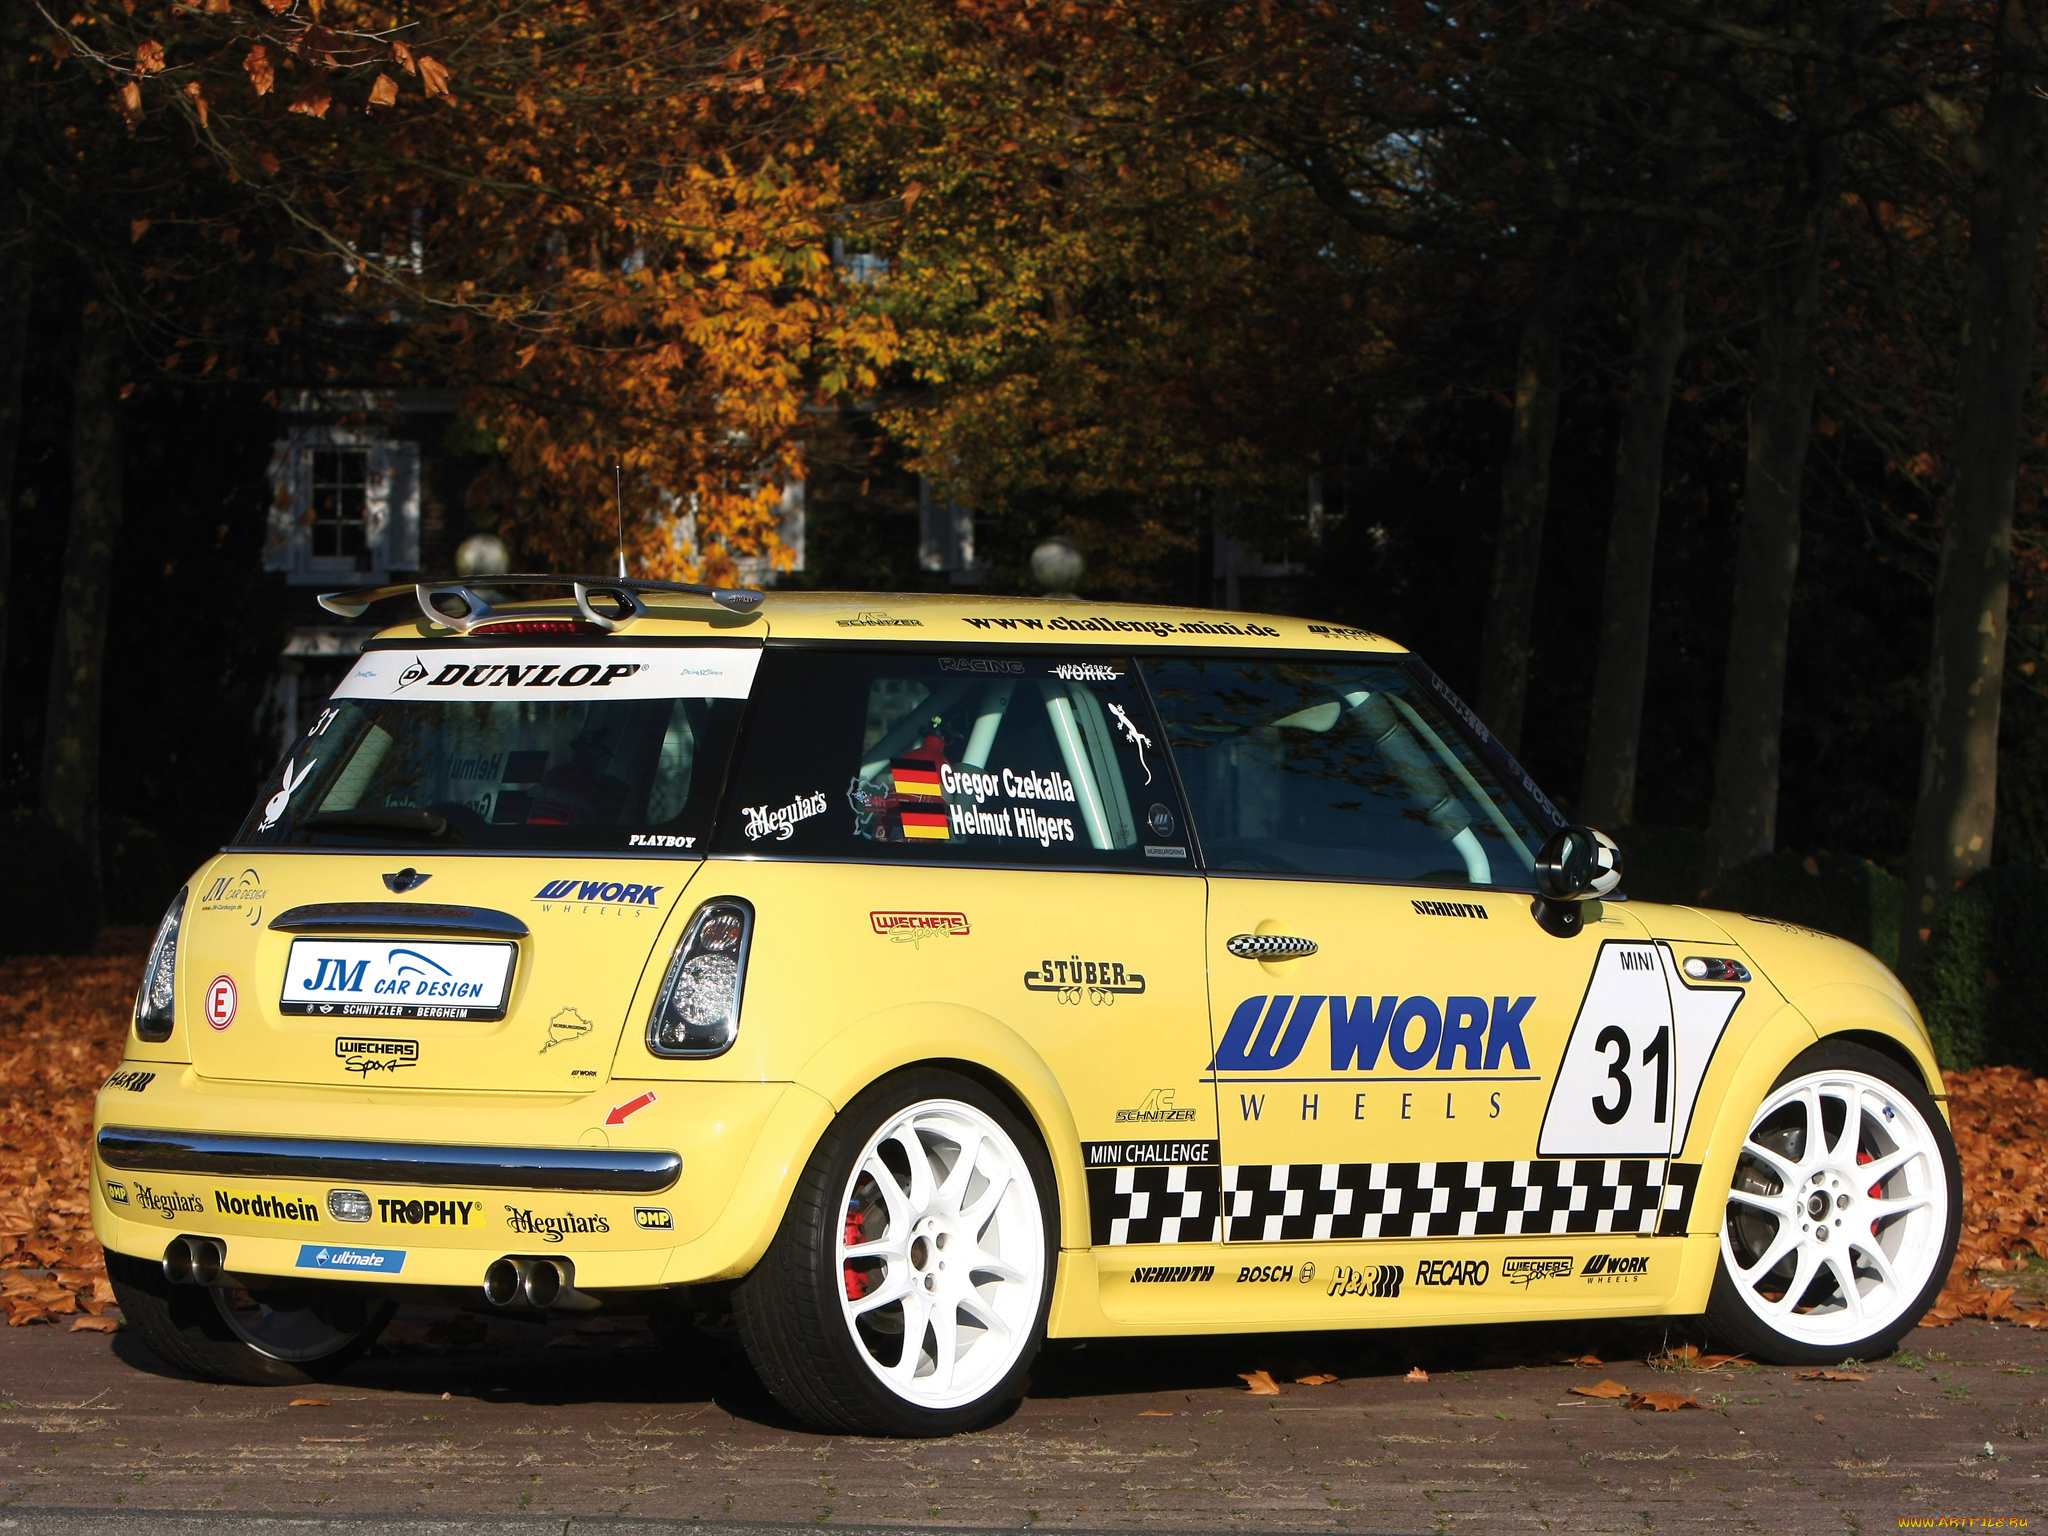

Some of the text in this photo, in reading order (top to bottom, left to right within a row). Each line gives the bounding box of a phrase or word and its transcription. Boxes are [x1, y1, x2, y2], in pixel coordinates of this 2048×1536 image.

[961, 616, 1281, 637] www.challenge.mini.de
[938, 657, 1025, 674] RACING
[1057, 665, 1117, 681] WORKS
[308, 707, 340, 737] 31
[940, 763, 1076, 804] Gregor Czekalla
[741, 790, 827, 842] Meguiar's
[949, 804, 1075, 848] Helmut Hilgers
[628, 834, 697, 849] PLAYBOY
[541, 905, 642, 918] WHEELS
[1041, 955, 1126, 986] STÜBER
[1620, 952, 1655, 972] MINI
[303, 957, 484, 999] JM CAR DESIGN
[342, 1004, 468, 1019] SCHNITZLER BERGHEIM
[339, 1041, 414, 1056] WIECHERS
[1591, 1024, 1670, 1126] 31
[1115, 1109, 1197, 1123] SCHNITZER
[1239, 1091, 1502, 1122] WHEELS
[1090, 1143, 1210, 1164] MINI CHALLENGE
[133, 1181, 204, 1220] Meguiar's
[214, 1190, 320, 1223] Nordrhein
[504, 1204, 611, 1243] Meguiar's
[637, 1210, 670, 1226] OMP
[331, 1250, 385, 1267] ultimate
[1236, 1266, 1294, 1283] BOSCH
[1415, 1260, 1489, 1286] RECARO
[1587, 1275, 1639, 1284] WHEELS
